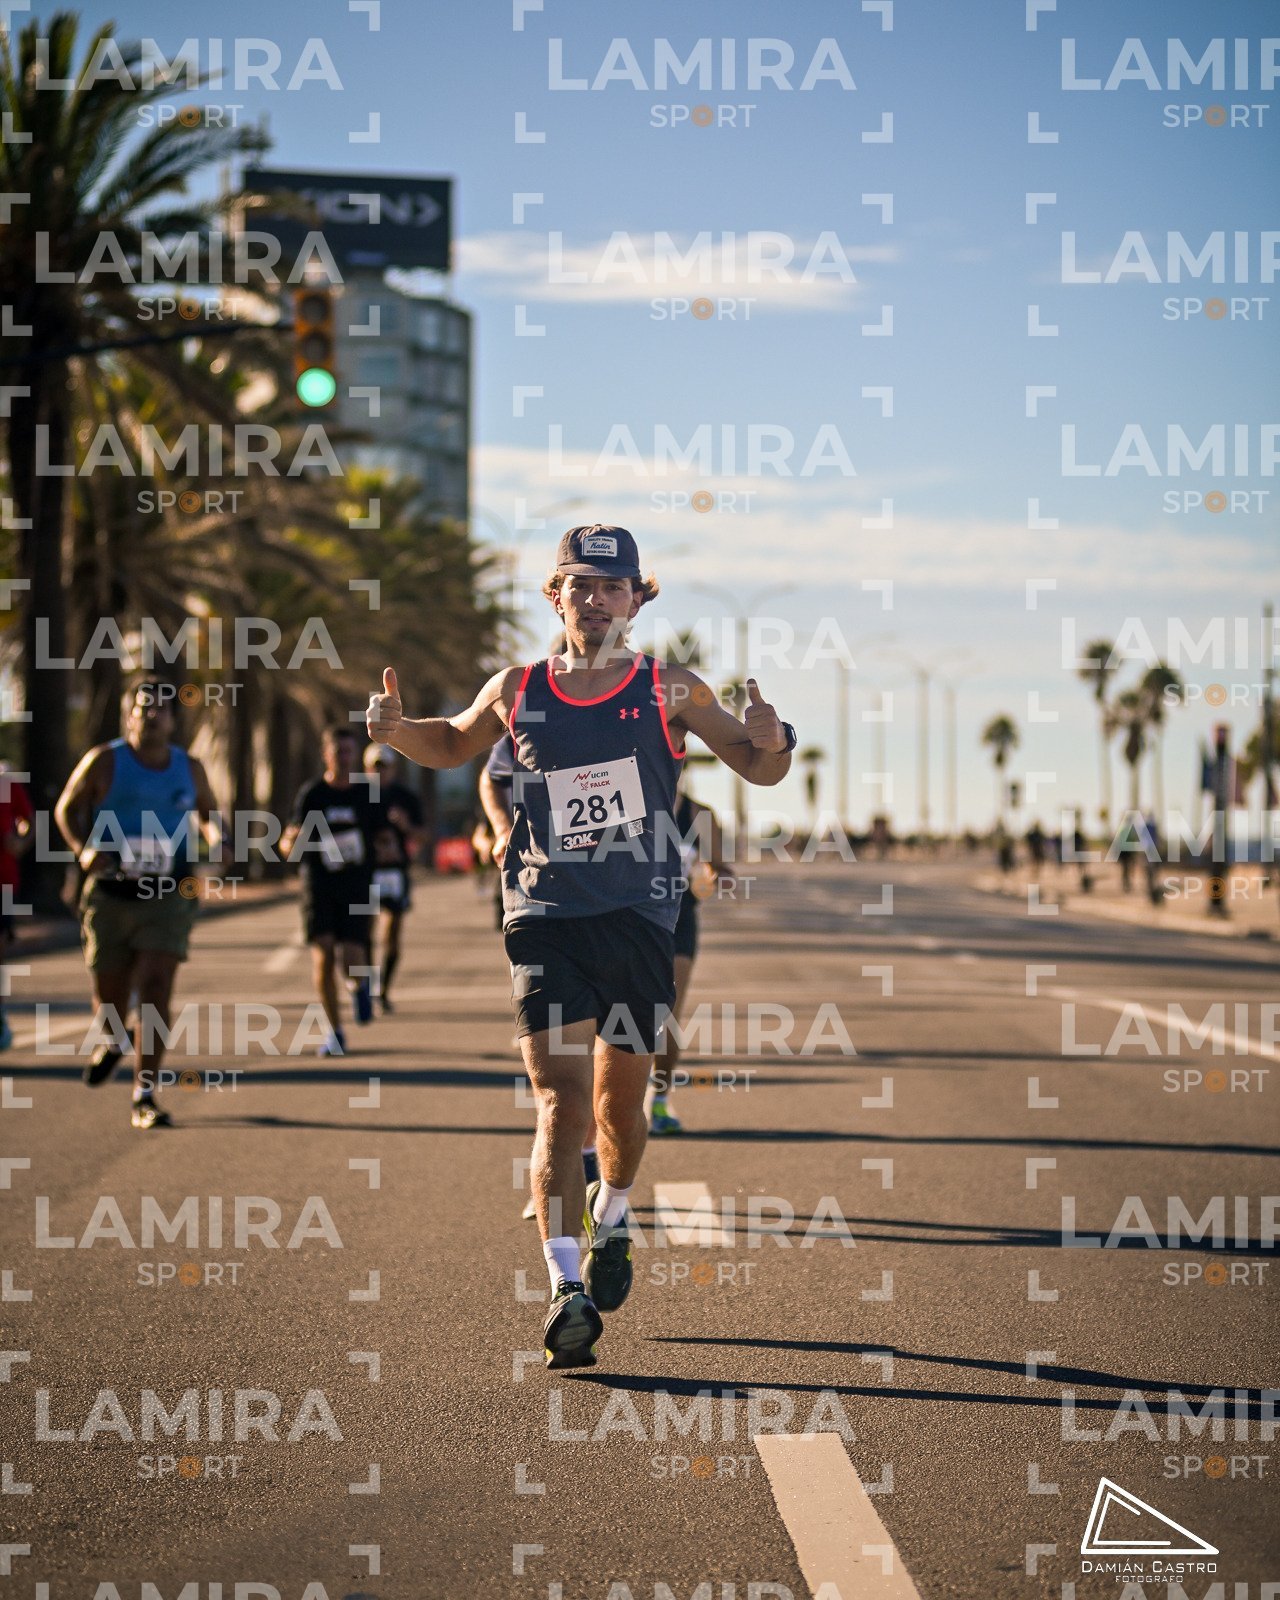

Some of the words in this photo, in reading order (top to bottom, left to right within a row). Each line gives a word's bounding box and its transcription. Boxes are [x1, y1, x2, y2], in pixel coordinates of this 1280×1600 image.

[591, 771, 608, 779] ucm
[567, 790, 625, 828] 281
[563, 832, 593, 851] 30K
